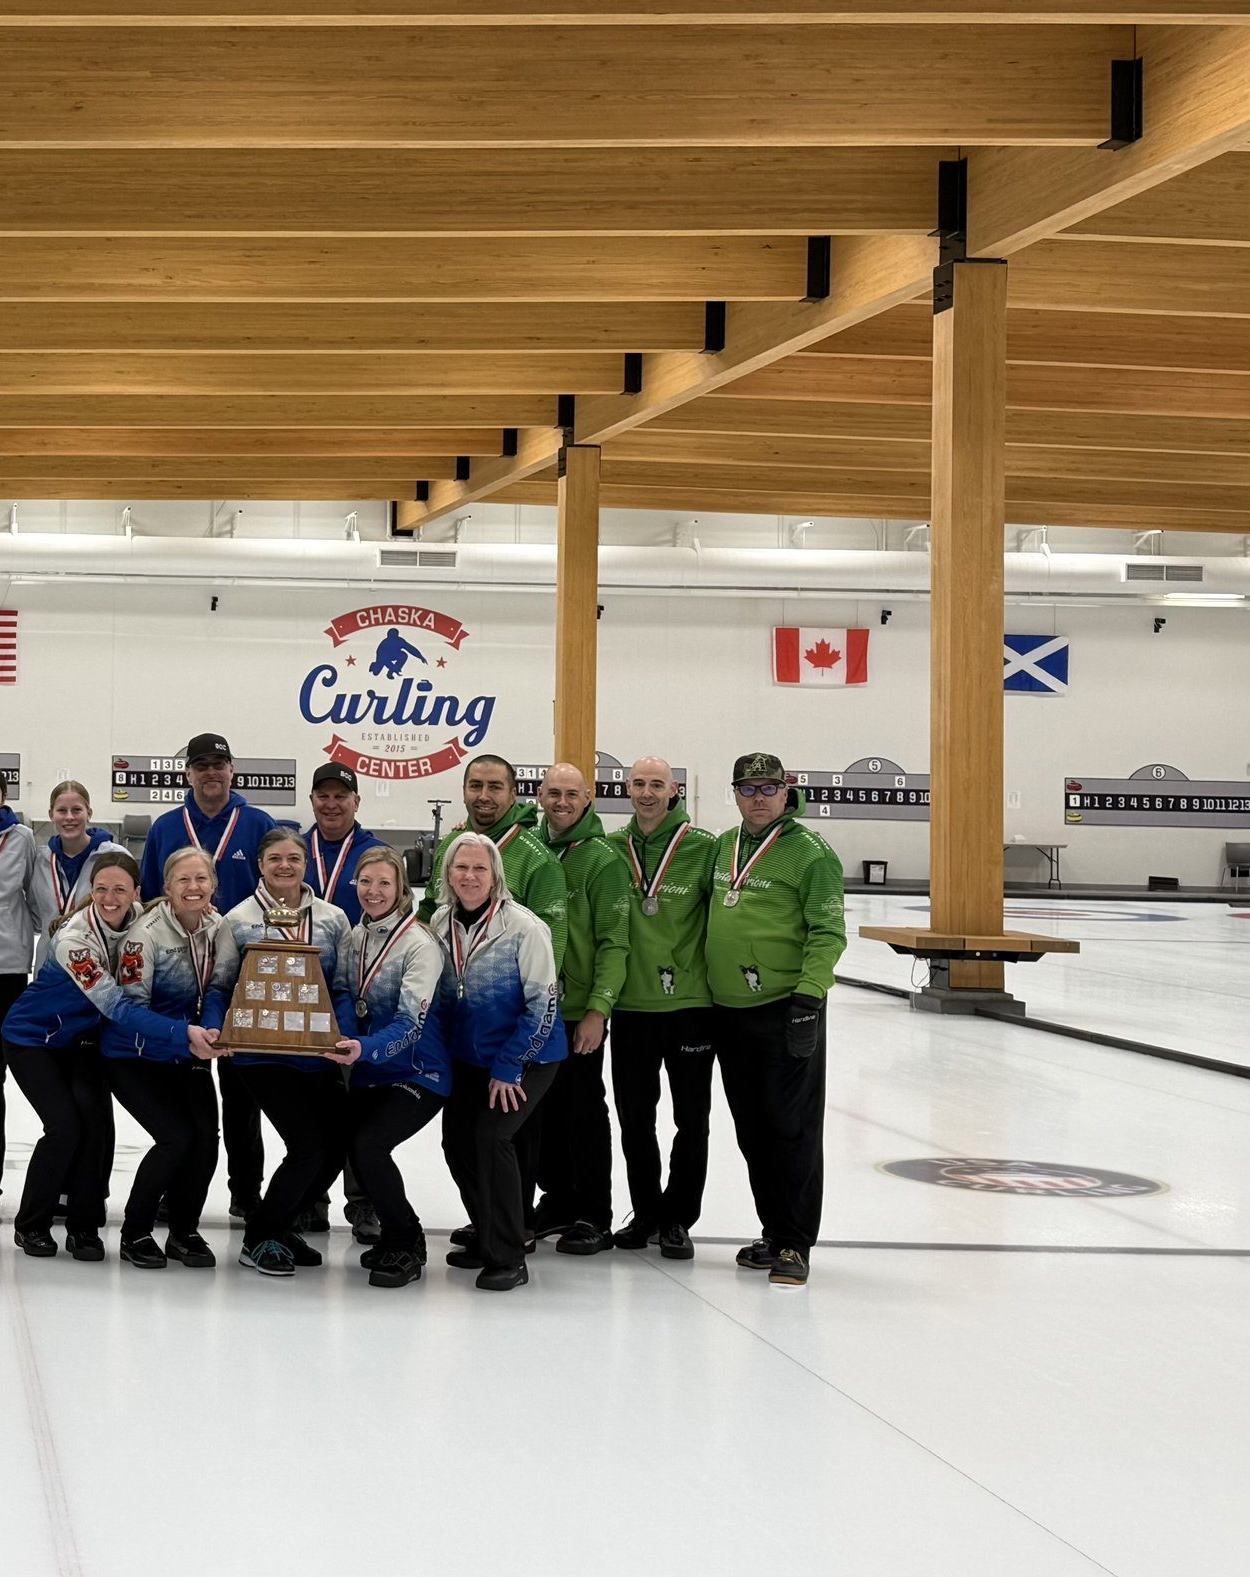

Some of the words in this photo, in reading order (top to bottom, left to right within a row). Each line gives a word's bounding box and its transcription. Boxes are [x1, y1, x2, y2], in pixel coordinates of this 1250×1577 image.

[356, 607, 437, 629] CHASKA
[299, 664, 497, 747] Curling
[361, 732, 430, 742] ESTABLISHED
[384, 744, 406, 753] 2015
[164, 761, 171, 769] 3
[177, 761, 183, 769] 5
[356, 757, 433, 778] CENTER
[871, 761, 878, 771] 5
[7, 772, 19, 782] 13
[518, 769, 525, 777] 3
[615, 770, 621, 779] 8
[1155, 767, 1162, 777] 6
[130, 774, 137, 784] H
[140, 774, 145, 784] 1
[151, 774, 158, 785] 2
[164, 774, 171, 785] 3
[176, 774, 183, 785] 4
[237, 776, 244, 787] 9
[247, 776, 258, 787] 10
[260, 776, 270, 787] 11
[272, 777, 282, 787] 12
[284, 777, 295, 787] 13
[800, 775, 806, 783] 5
[834, 776, 841, 784] 3
[897, 777, 903, 786] 6
[518, 783, 524, 793] H
[528, 783, 534, 794] 1
[602, 784, 609, 795] 7
[614, 785, 621, 795] 8
[152, 791, 158, 799] 2
[164, 791, 170, 799] 4
[176, 791, 183, 799] 6
[809, 789, 815, 799] 1
[821, 789, 828, 800] 2
[834, 790, 841, 801] 3
[846, 790, 853, 801] 4
[859, 791, 866, 801] 5
[871, 791, 879, 802] 6
[884, 791, 891, 802] 7
[896, 792, 904, 802] 8
[909, 792, 916, 803] 9
[919, 792, 930, 803] 10
[1084, 796, 1090, 807] H
[1094, 796, 1100, 807] 1
[1105, 796, 1112, 807] 2
[1118, 797, 1125, 807] 3
[1130, 797, 1137, 808] 4
[1142, 797, 1150, 808] 5
[1155, 798, 1162, 809] 6
[1168, 798, 1175, 809] 7
[1180, 798, 1187, 809] 8
[1192, 798, 1200, 809] 9
[1203, 799, 1214, 809] 10
[1215, 799, 1226, 810] 11
[1227, 799, 1239, 810] 12
[1240, 799, 1250, 810] 13
[821, 806, 828, 815] 4
